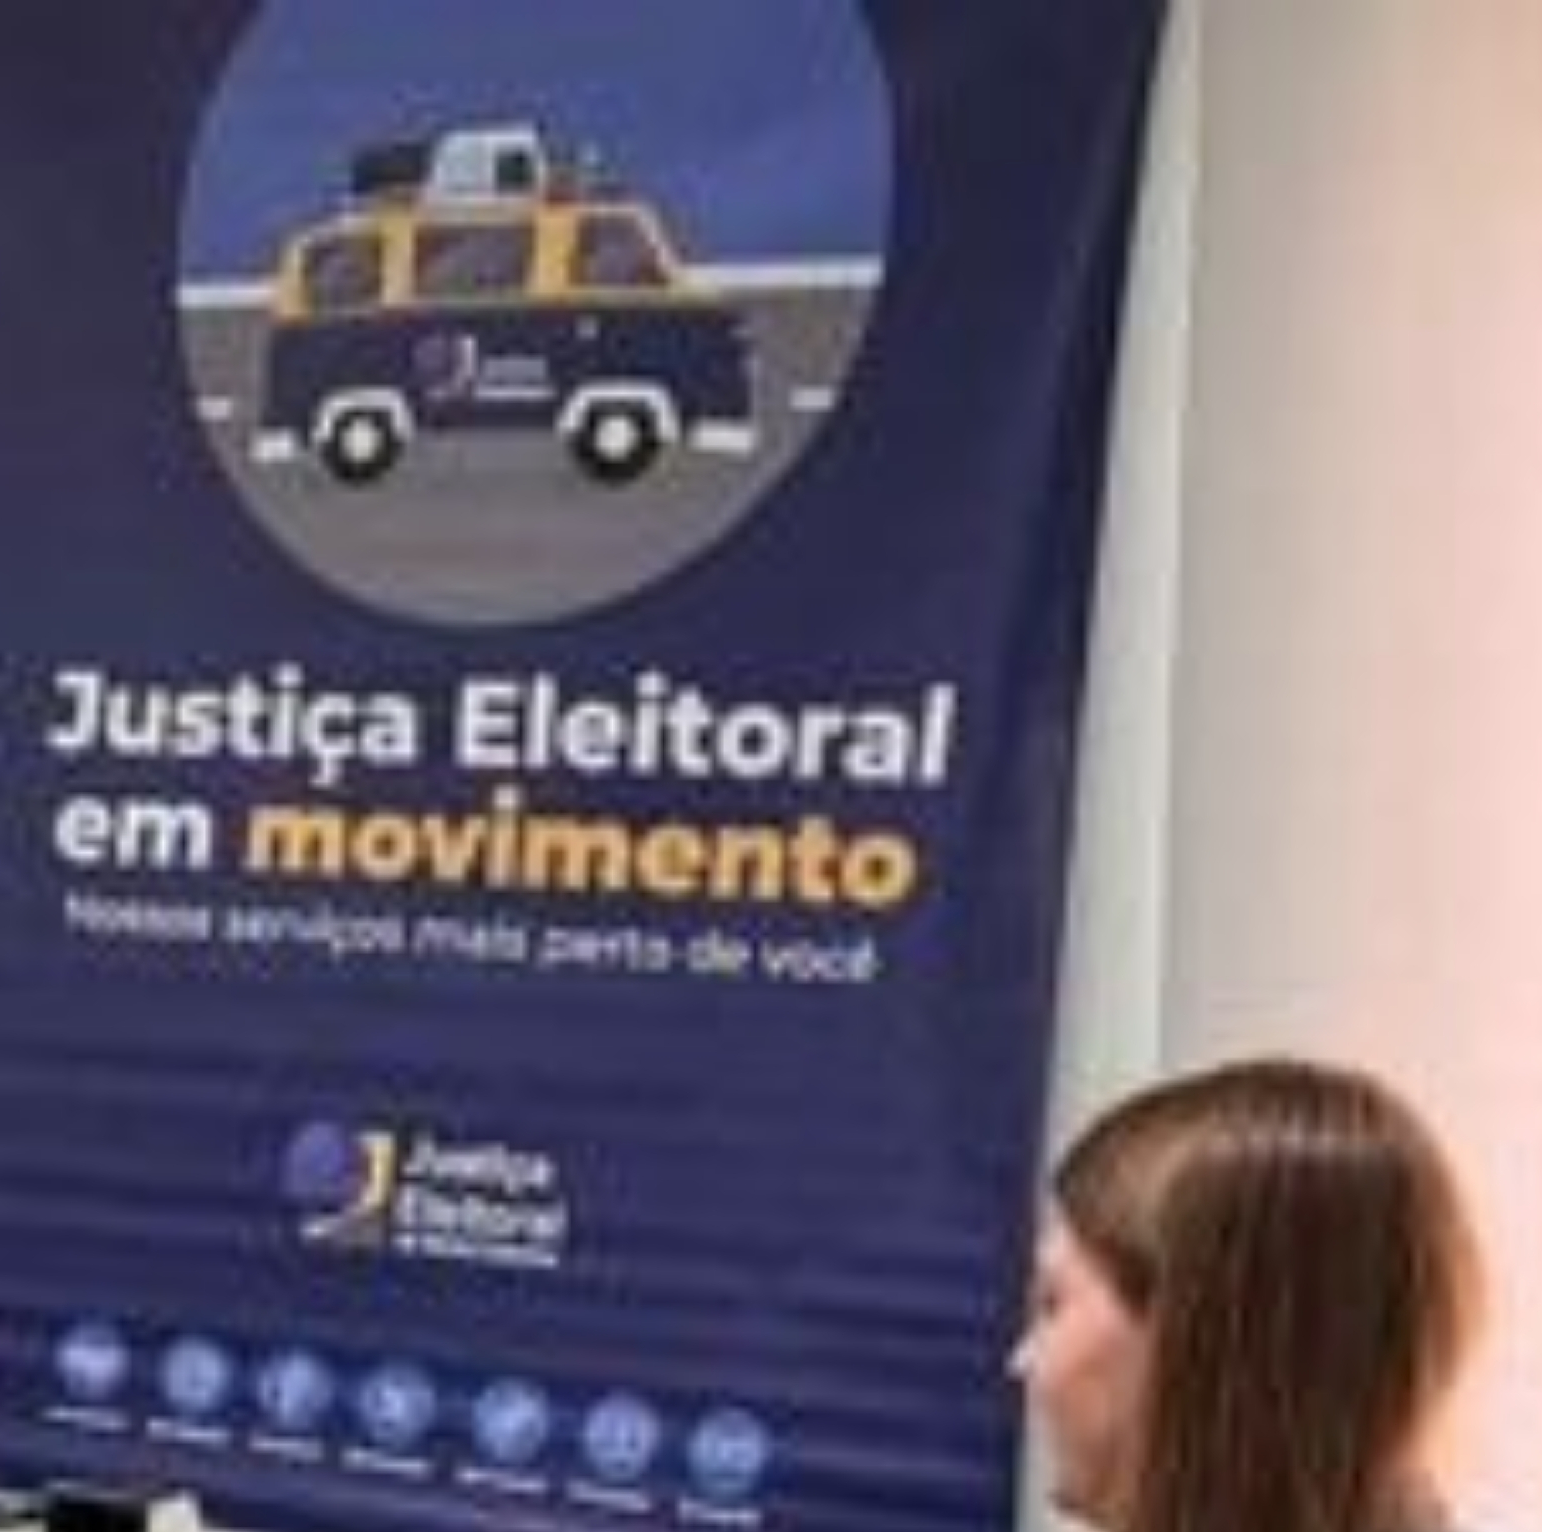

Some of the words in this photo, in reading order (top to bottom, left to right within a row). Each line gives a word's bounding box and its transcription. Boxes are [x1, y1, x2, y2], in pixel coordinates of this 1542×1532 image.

[46, 664, 418, 786] Justiça
[455, 674, 959, 786] Eleitoral
[53, 797, 214, 867] em
[244, 785, 921, 910] movimento
[225, 898, 405, 962] serviços
[414, 905, 527, 962] mais
[685, 928, 750, 976] de
